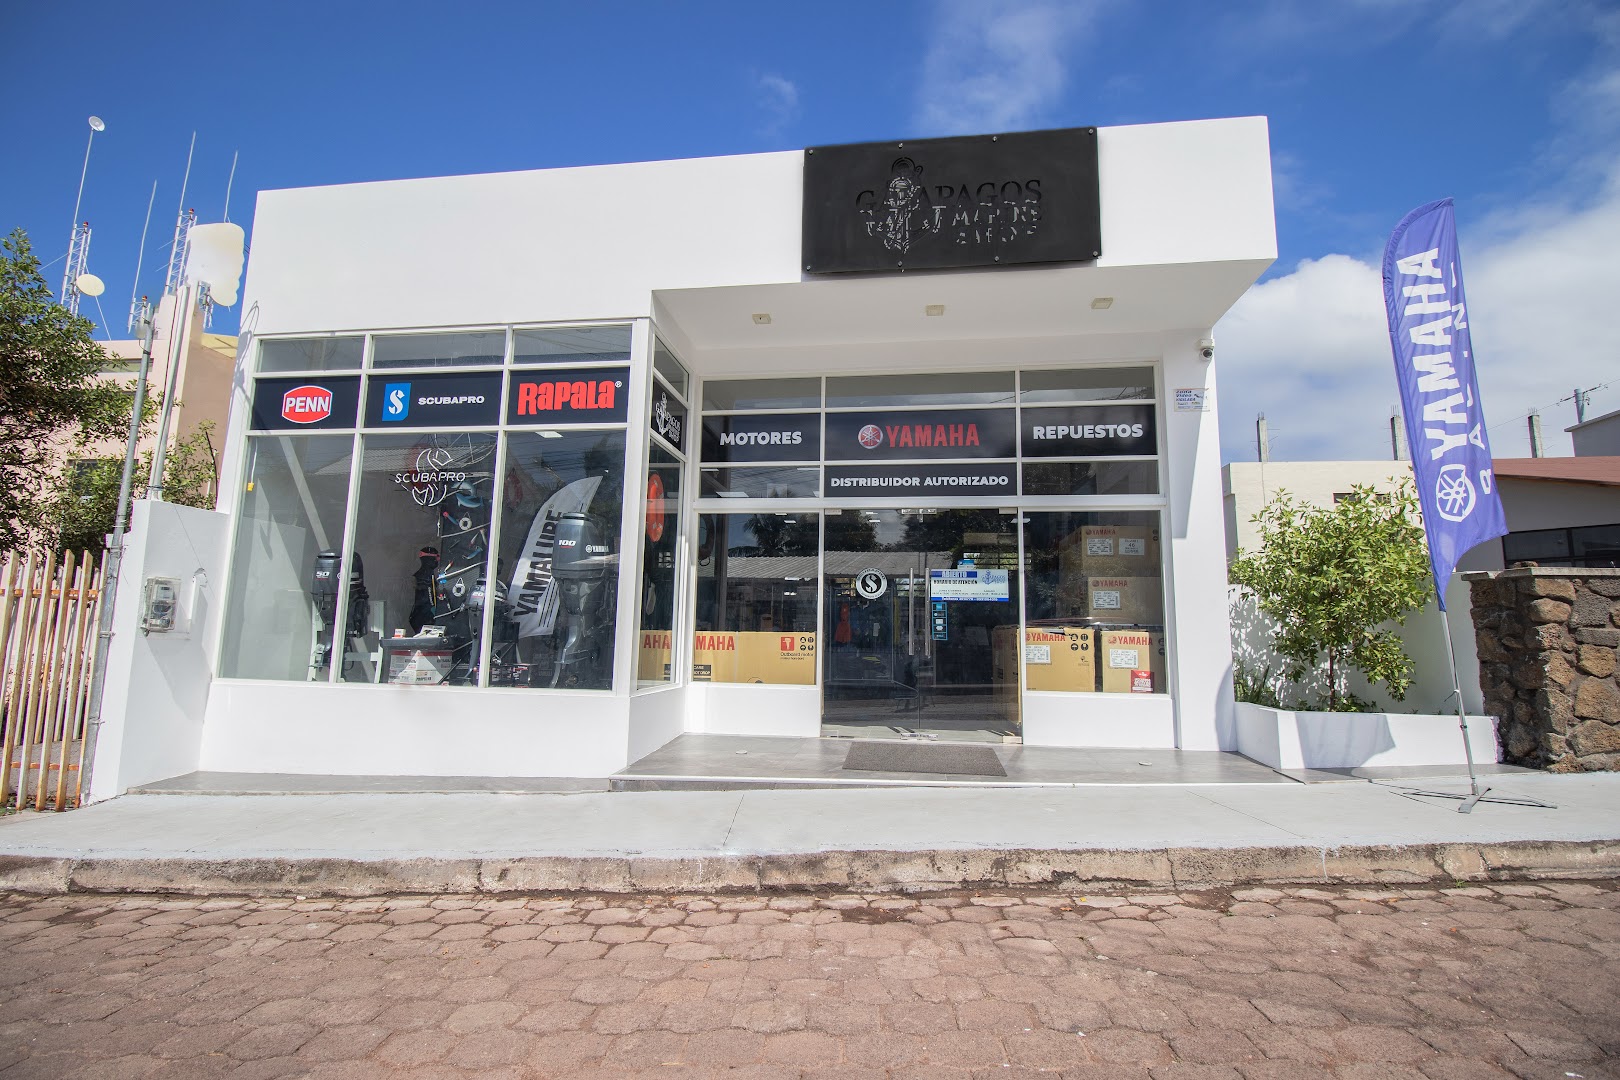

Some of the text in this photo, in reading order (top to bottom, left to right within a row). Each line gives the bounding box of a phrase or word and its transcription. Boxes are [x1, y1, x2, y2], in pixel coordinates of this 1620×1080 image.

[1396, 247, 1468, 461] YAMAHA
[284, 396, 330, 413] PENN
[418, 395, 485, 406] SCUBAPRO
[885, 423, 980, 448] YAMAHA
[1033, 423, 1144, 440] REPUESTOS
[719, 431, 803, 446] MOTORES
[394, 472, 466, 484] SCUBAPRO
[830, 475, 1009, 487] DISTRIBUIDOR AUTORIZADO
[1031, 633, 1066, 642] YAMAHA
[1118, 636, 1153, 646] YAMAHA
